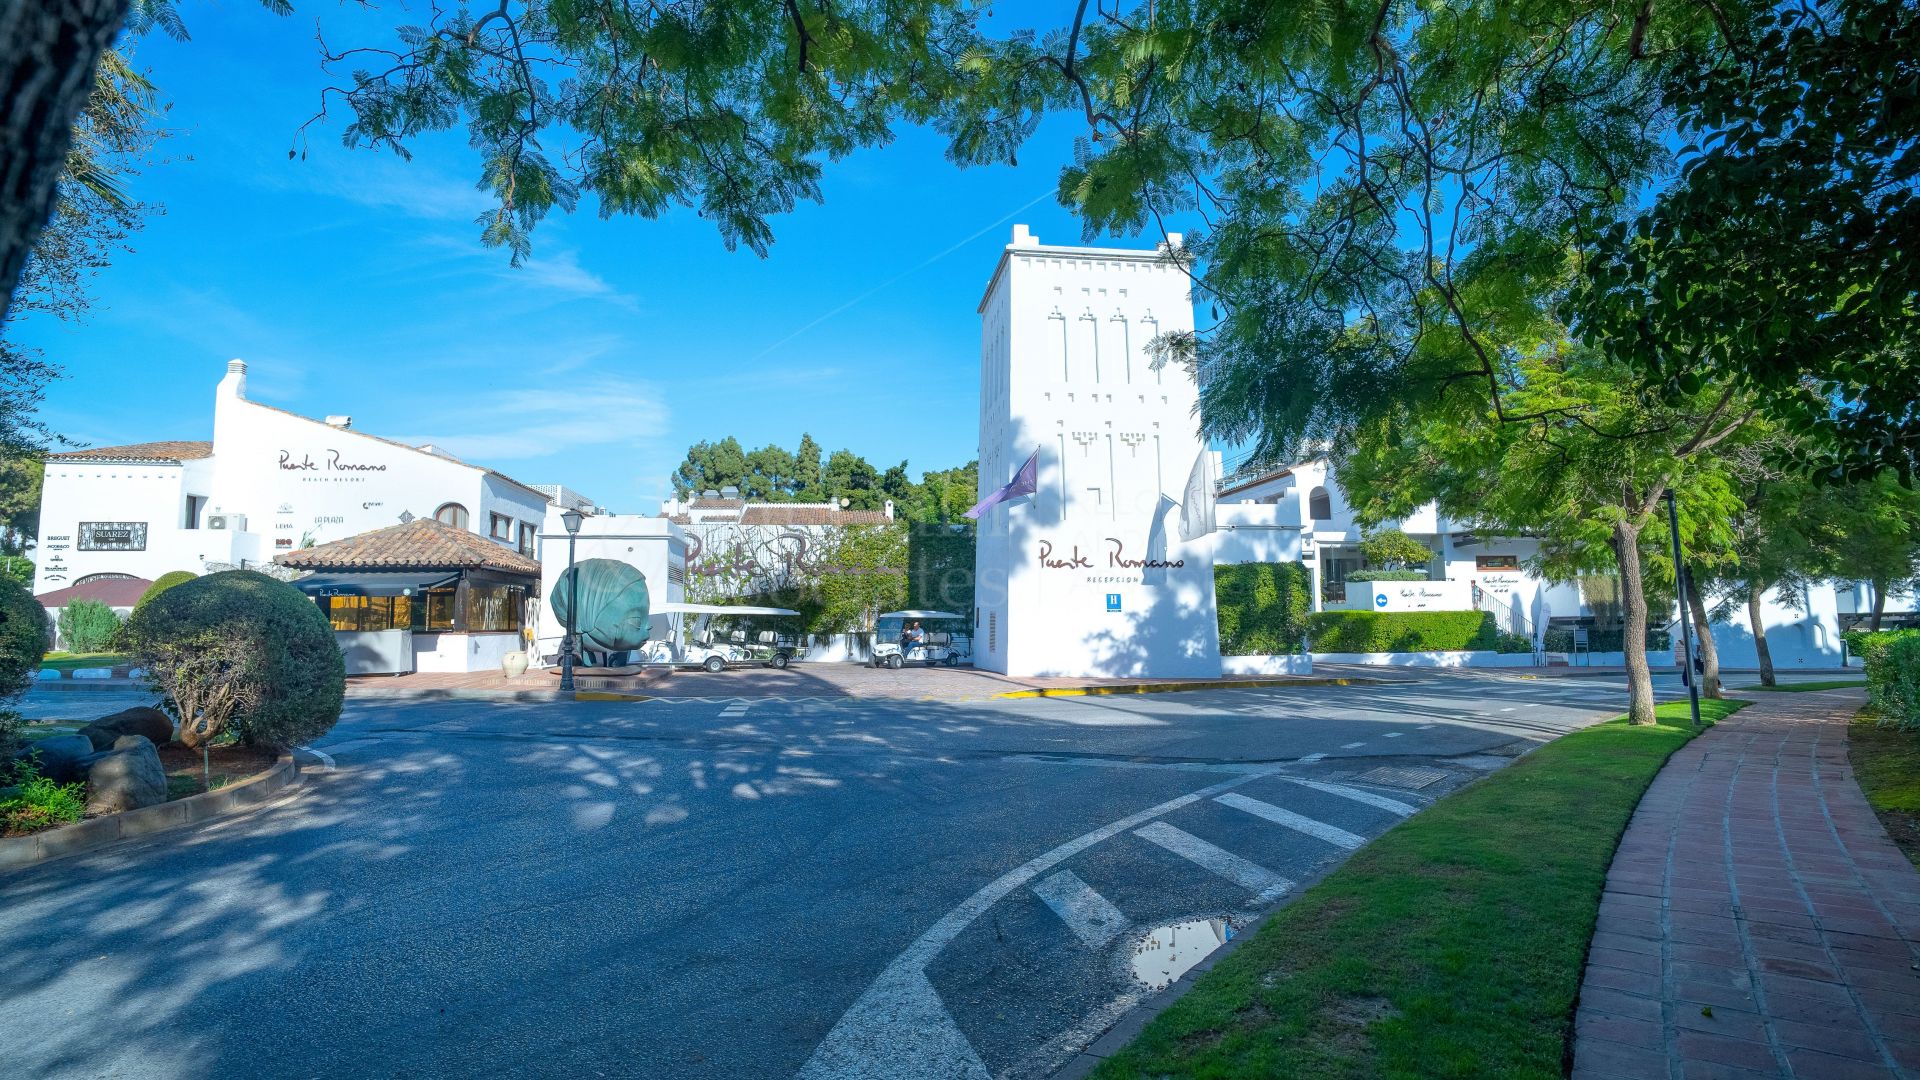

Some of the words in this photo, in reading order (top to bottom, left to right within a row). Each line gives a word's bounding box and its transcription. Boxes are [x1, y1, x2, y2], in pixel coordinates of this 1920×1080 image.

[279, 449, 319, 471] Puente
[326, 448, 387, 472] Romano
[1038, 539, 1094, 569] Puente
[1105, 537, 1185, 569] Romano
